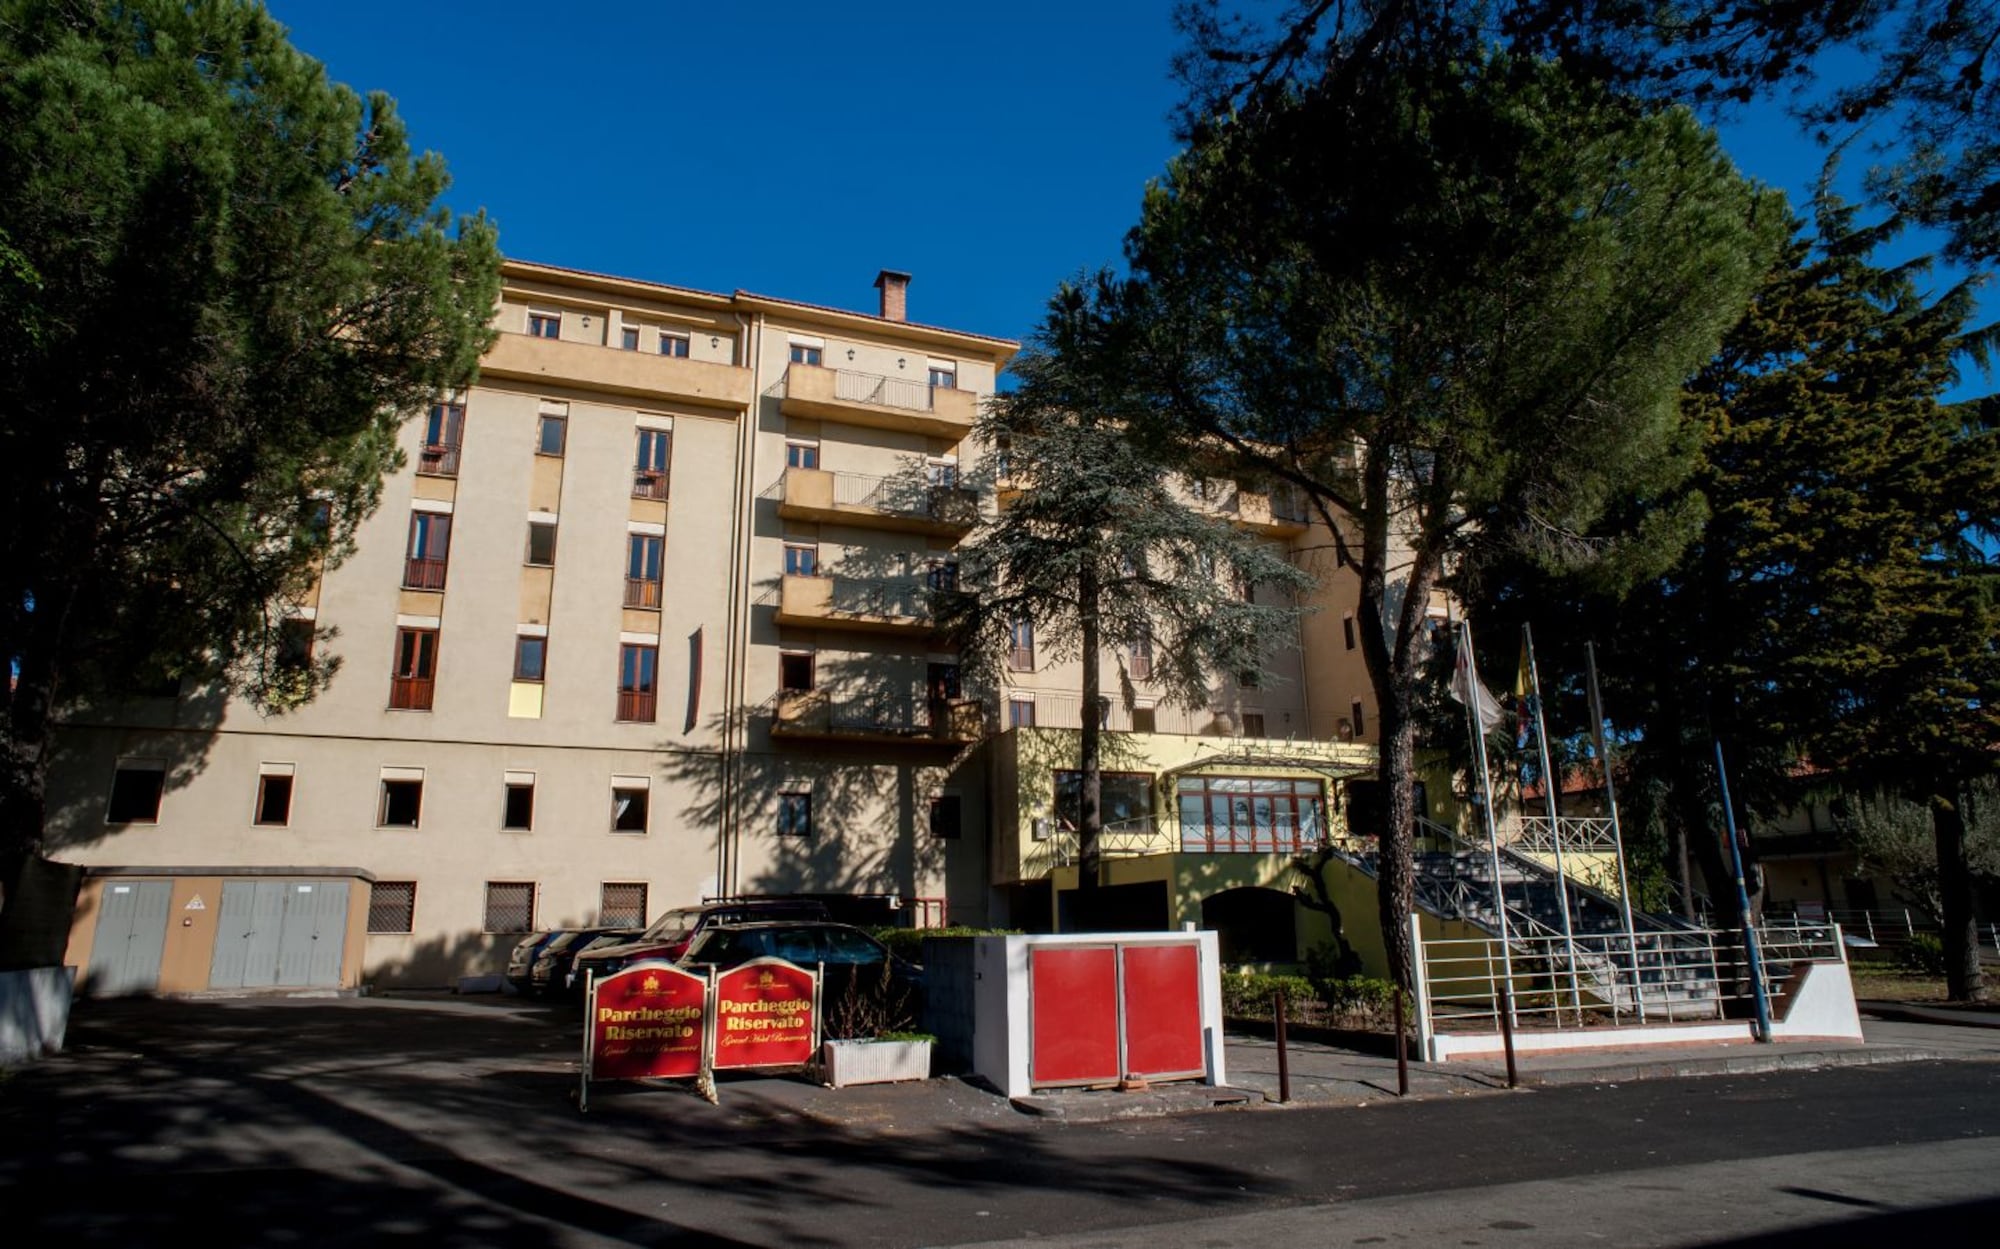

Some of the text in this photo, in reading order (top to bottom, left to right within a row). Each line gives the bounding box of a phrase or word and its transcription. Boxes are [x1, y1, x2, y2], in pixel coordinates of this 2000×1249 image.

[599, 1006, 702, 1023] Parcheggio
[720, 998, 811, 1015] Parcheggio
[727, 1016, 804, 1030] Riservato
[606, 1025, 694, 1040] Riservato
